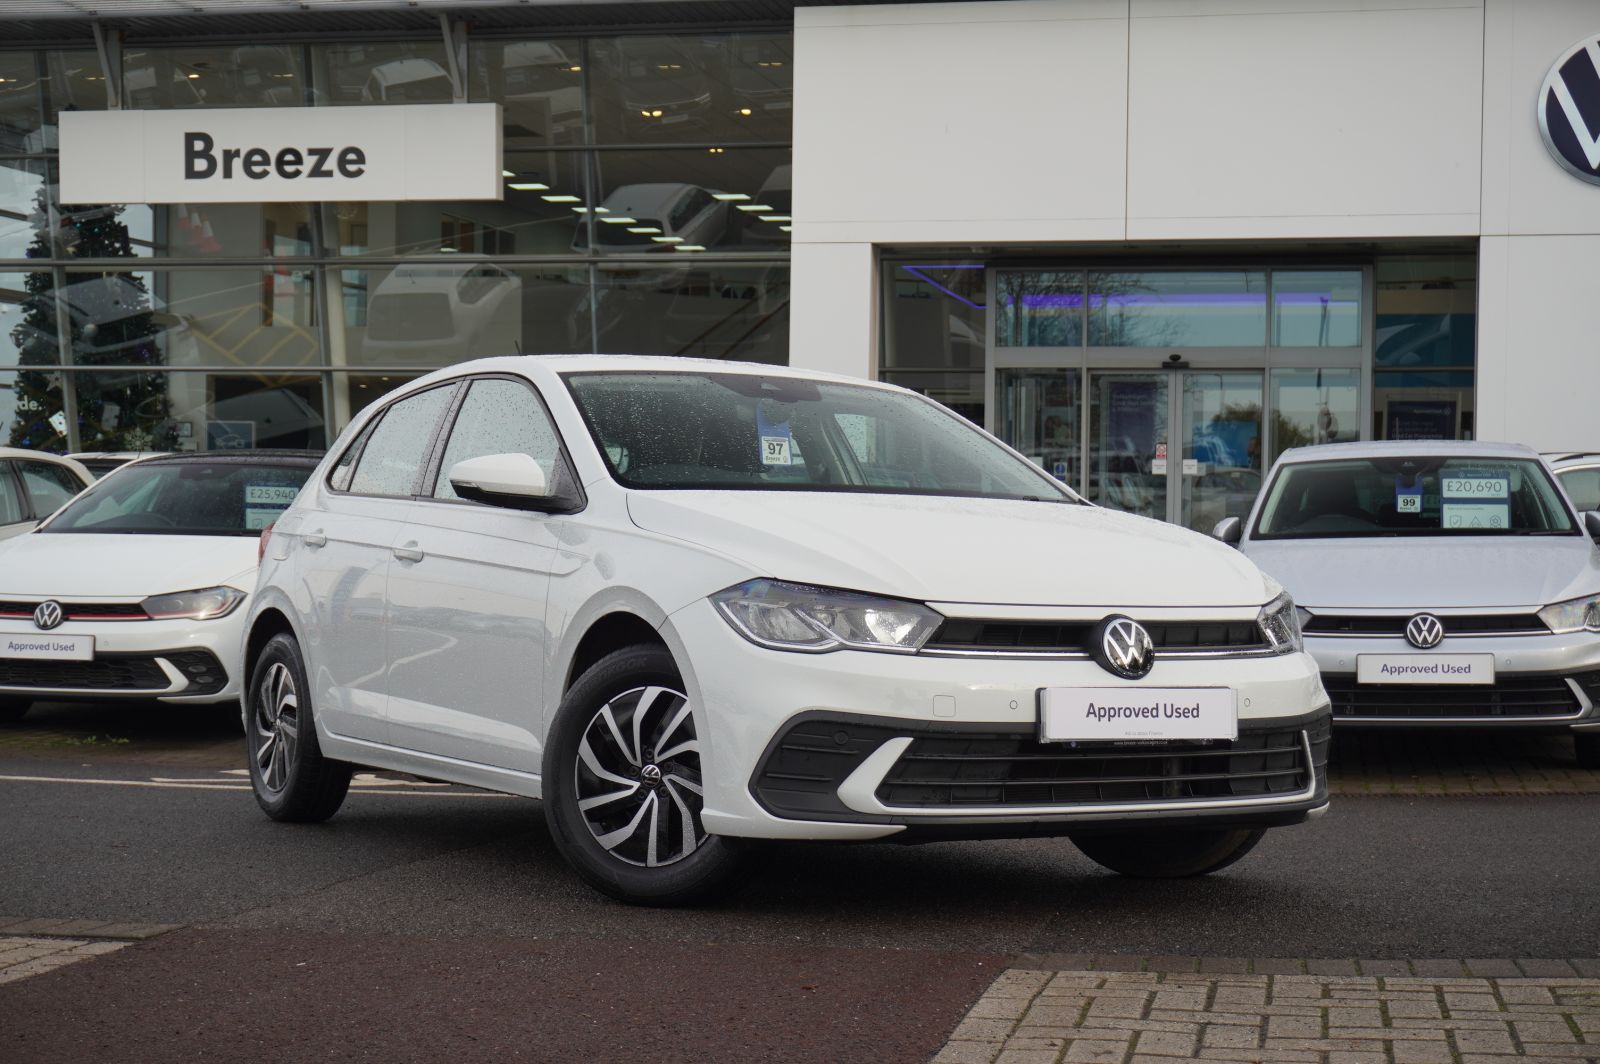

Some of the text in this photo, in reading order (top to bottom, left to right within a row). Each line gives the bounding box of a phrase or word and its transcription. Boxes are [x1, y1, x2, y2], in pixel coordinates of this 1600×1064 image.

[184, 131, 367, 180] Breeze
[767, 442, 784, 455] 97
[250, 488, 296, 500] £25,940
[1447, 481, 1502, 494] £20,690
[1402, 498, 1416, 507] 99
[8, 641, 75, 652] Approved Used
[1380, 663, 1471, 676] Approved Used
[1086, 702, 1200, 722] Approved Used
